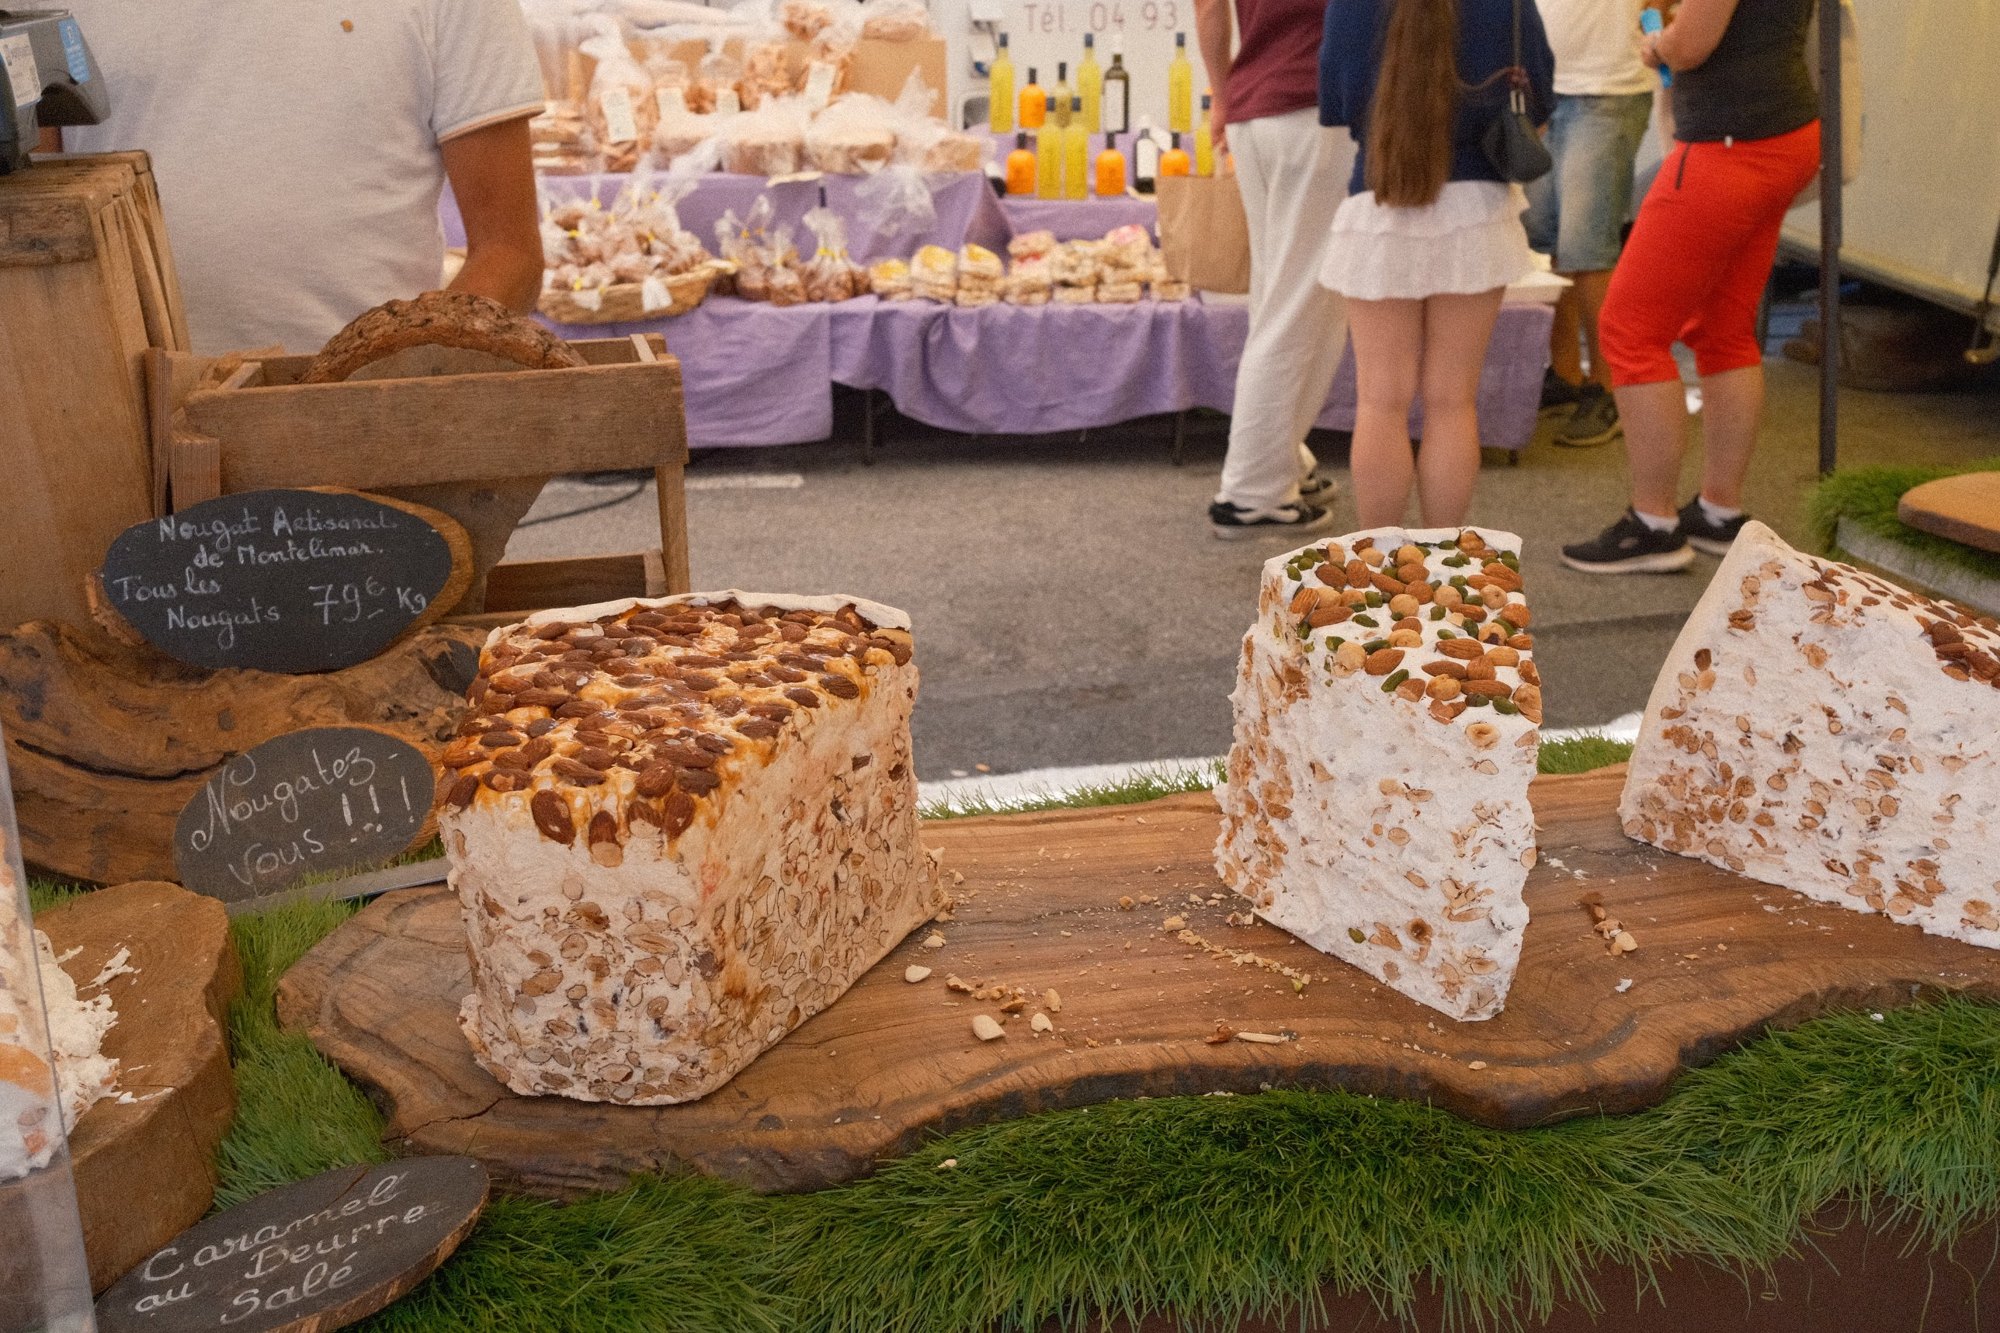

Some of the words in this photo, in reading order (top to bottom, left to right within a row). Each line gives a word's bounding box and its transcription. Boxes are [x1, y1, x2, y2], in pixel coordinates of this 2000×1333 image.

[1089, 1, 1125, 32] 04
[1140, 1, 1178, 31] 93
[159, 508, 261, 550] Nougat
[193, 545, 224, 568] de
[113, 576, 177, 601] Tous
[185, 566, 220, 594] les
[167, 597, 280, 649] Nougats
[396, 586, 427, 614] Kg
[140, 1171, 410, 1282] Caramel
[135, 1282, 196, 1313] au
[244, 1204, 428, 1280] Beurre
[220, 1252, 359, 1326] Salé
